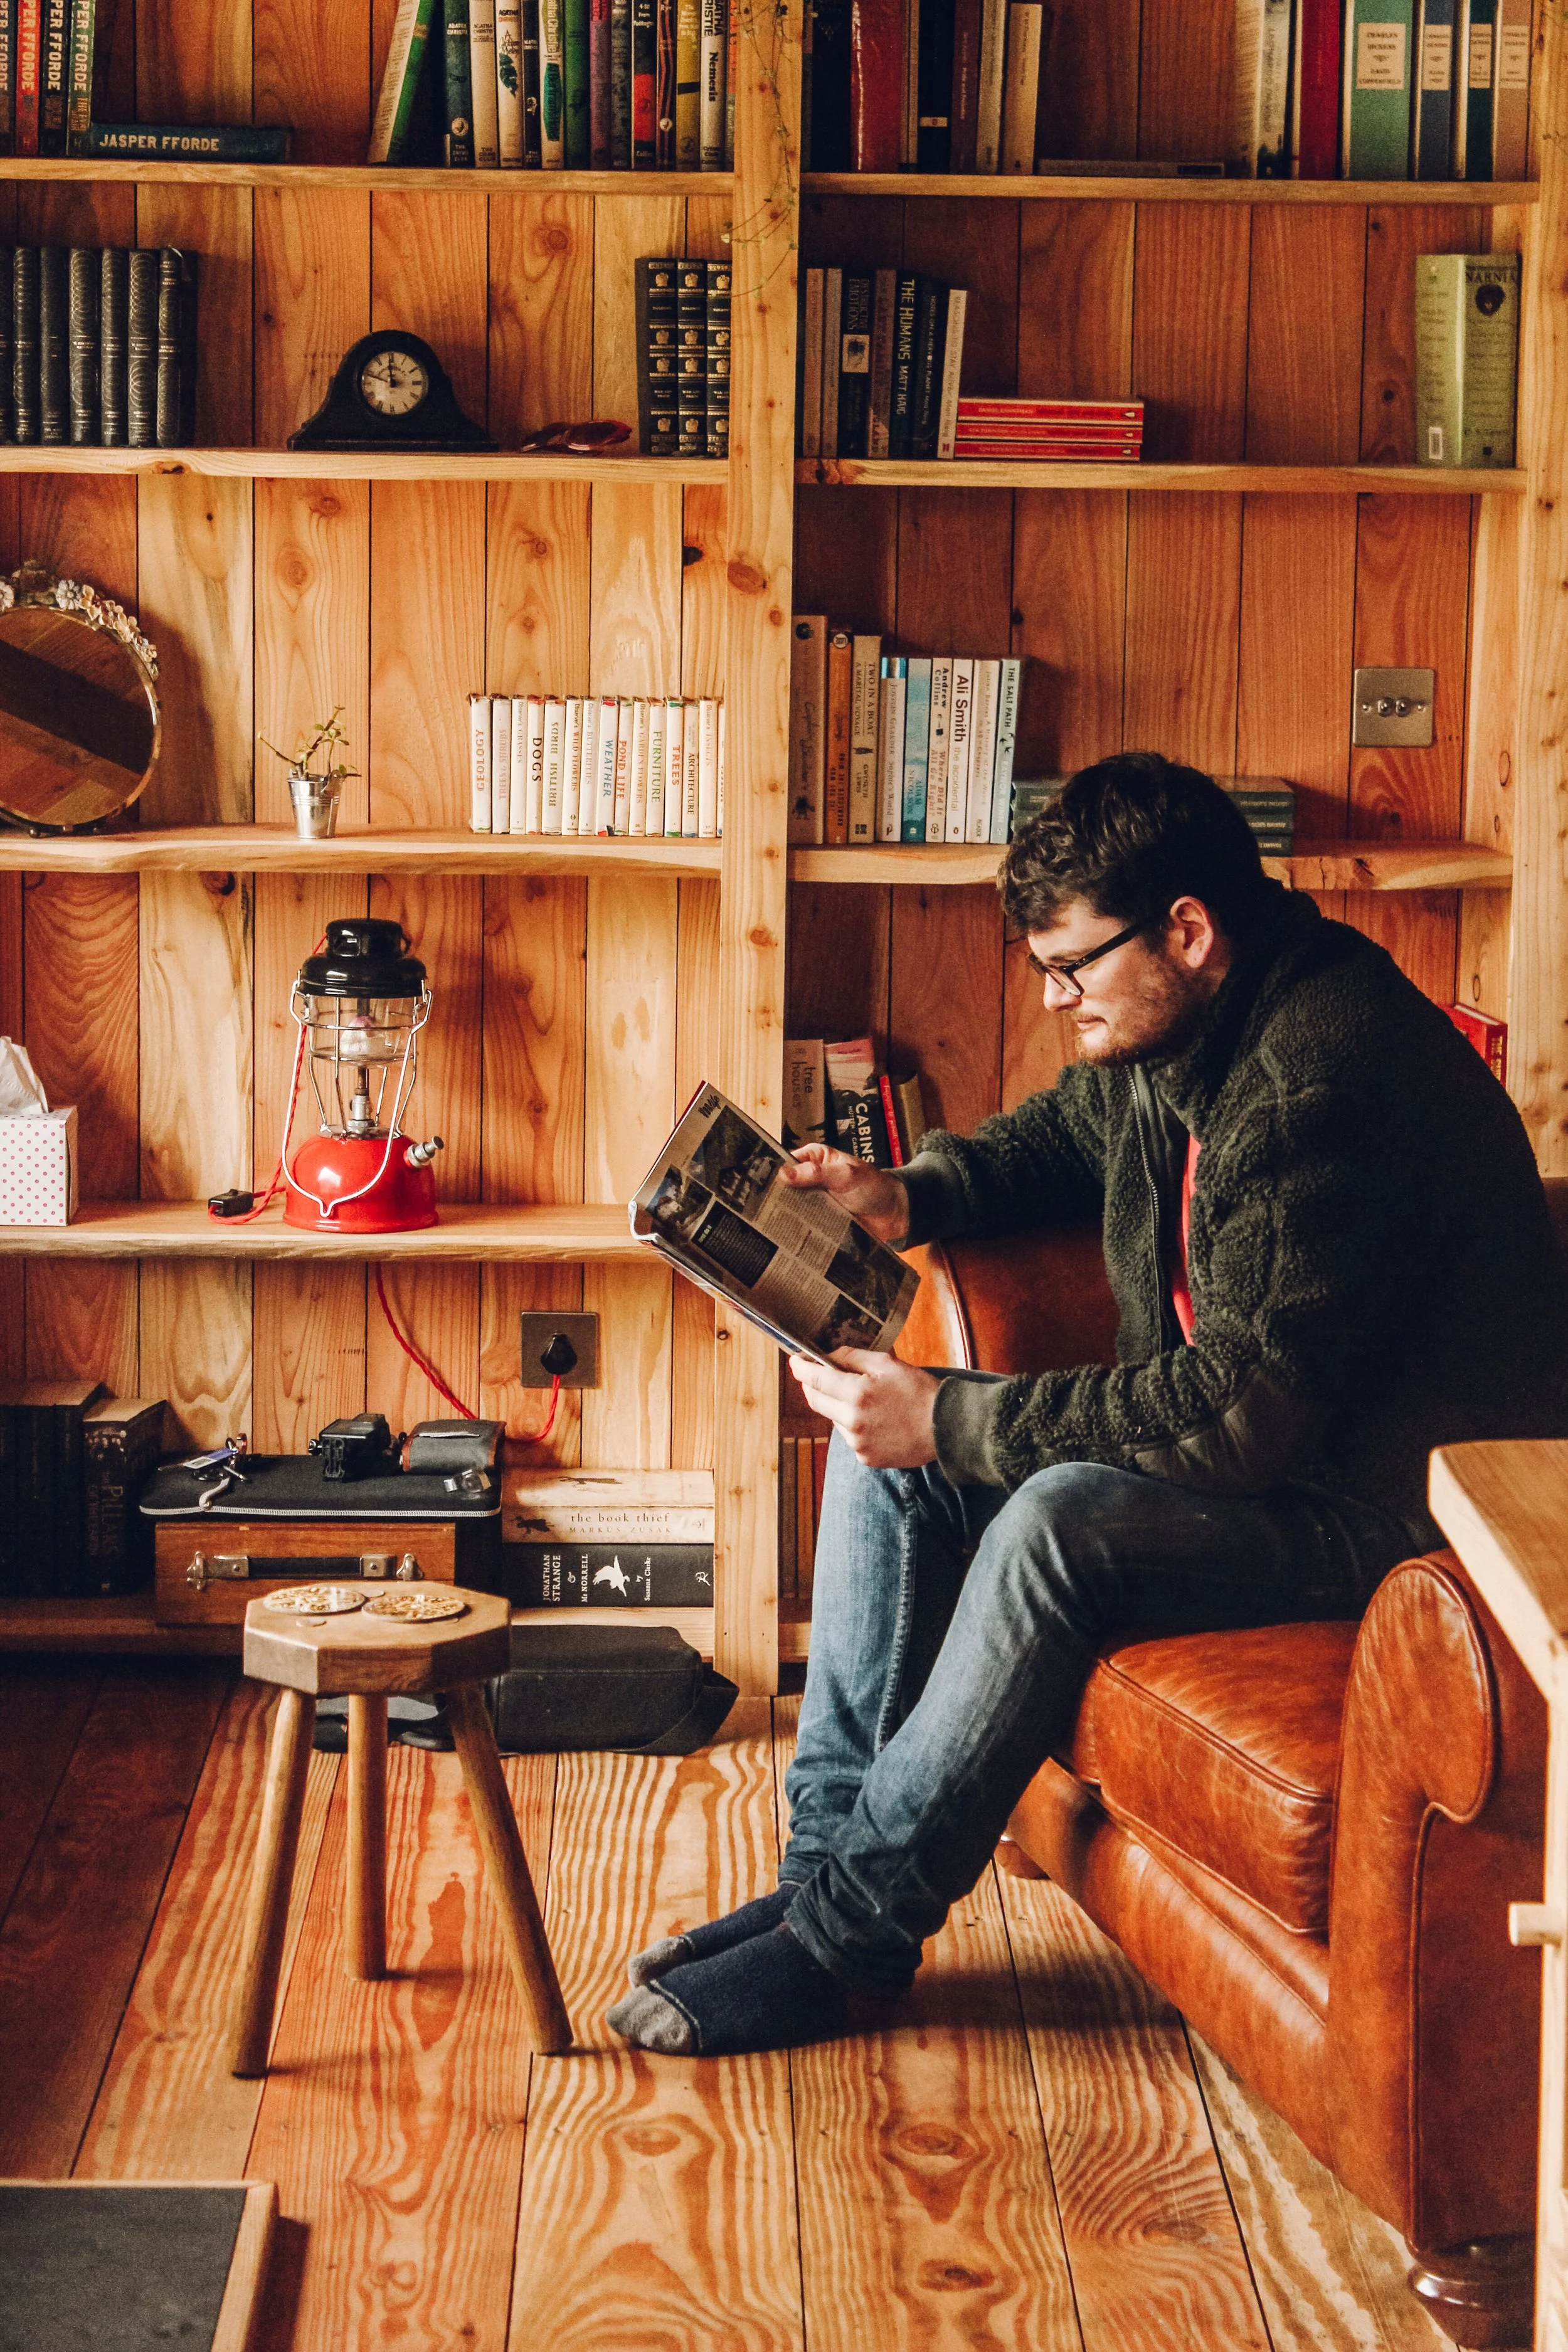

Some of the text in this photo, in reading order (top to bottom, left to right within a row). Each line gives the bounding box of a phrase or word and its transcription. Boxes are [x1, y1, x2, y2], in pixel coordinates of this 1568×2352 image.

[547, 18, 559, 53] Christie
[21, 33, 35, 91] FFORDE
[48, 33, 62, 90] FFORDE
[74, 34, 88, 91] FFORDE
[709, 52, 719, 102] Nemesis
[100, 134, 220, 151] JASPER FFORDE
[847, 278, 859, 330] EMOTIONS
[901, 279, 914, 303] THE
[898, 307, 914, 361] HUMANS
[898, 366, 909, 391] MATT
[867, 662, 876, 685] TWO
[868, 687, 875, 698] IN
[933, 669, 941, 706] Collins
[941, 667, 950, 708] Andrew
[954, 674, 970, 743] Ali Smith
[1006, 685, 1014, 704] SALT
[866, 710, 874, 736] BOAT
[1004, 707, 1012, 728] PATH
[499, 729, 507, 763] SHRUBS
[550, 722, 559, 754] BIRDS
[475, 729, 485, 791] GEOLOGY
[532, 738, 543, 781] DOGS
[571, 755, 579, 792] FLOWERS
[603, 739, 613, 797] WEATHER
[616, 740, 627, 800] POND LIFE
[651, 731, 662, 803] FURNITURE
[672, 745, 681, 786] TREES
[499, 773, 507, 800] TREES
[548, 763, 558, 807] BRITISH
[687, 753, 696, 815] ARCHITECTURE
[950, 747, 961, 812] the accidental
[886, 792, 894, 815] World
[997, 798, 1006, 823] WINN
[792, 1061, 808, 1108] houses
[804, 1067, 816, 1093] tree
[855, 1103, 875, 1164] CABINS
[571, 1512, 670, 1523] the book thief
[543, 1554, 551, 1601] JONATHAN
[552, 1555, 561, 1602] STRANGE
[567, 1572, 576, 1584] &
[581, 1592, 588, 1602] Mr
[635, 1574, 644, 1583] by
